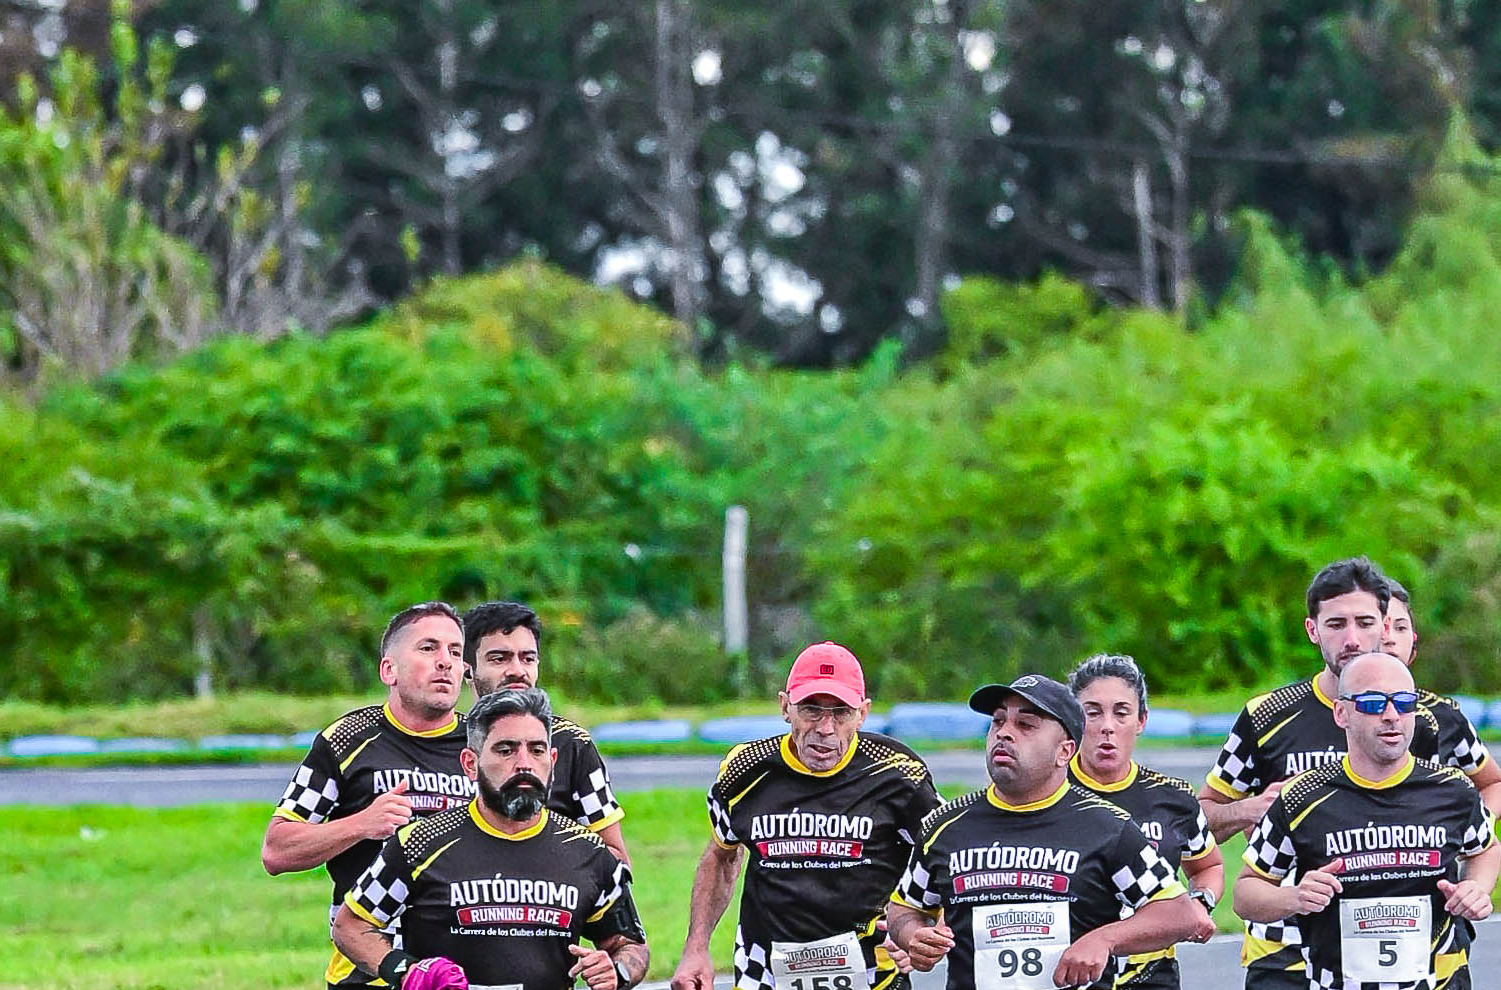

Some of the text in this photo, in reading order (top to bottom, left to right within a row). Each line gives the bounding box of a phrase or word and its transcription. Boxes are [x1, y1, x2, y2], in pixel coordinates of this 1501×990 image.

[373, 766, 479, 798] AUTÓDROM
[751, 807, 874, 840] AUTÓDROMO
[767, 841, 852, 857] RUNNING RACE
[1325, 821, 1447, 857] AUTÓDROMO
[949, 841, 1080, 877] AUTÓDROMO
[1344, 851, 1430, 871] RUNNING RACE
[964, 872, 1055, 890] RUNNING RACE
[1360, 873, 1370, 881] de
[450, 873, 579, 910] AUTÓDROMO
[979, 893, 989, 901] de
[990, 893, 1001, 901] los
[1002, 892, 1028, 901] Clubes
[1029, 892, 1042, 901] del
[470, 907, 562, 925] RUNNING RACE
[986, 908, 1055, 929] AUTÓDROMO
[450, 926, 459, 934] La
[459, 926, 486, 936] Carrera
[487, 927, 497, 936] de
[498, 927, 509, 936] los
[510, 928, 535, 937] Clubes
[536, 928, 548, 937] del
[998, 947, 1043, 977] 98
[1378, 941, 1398, 967] 5
